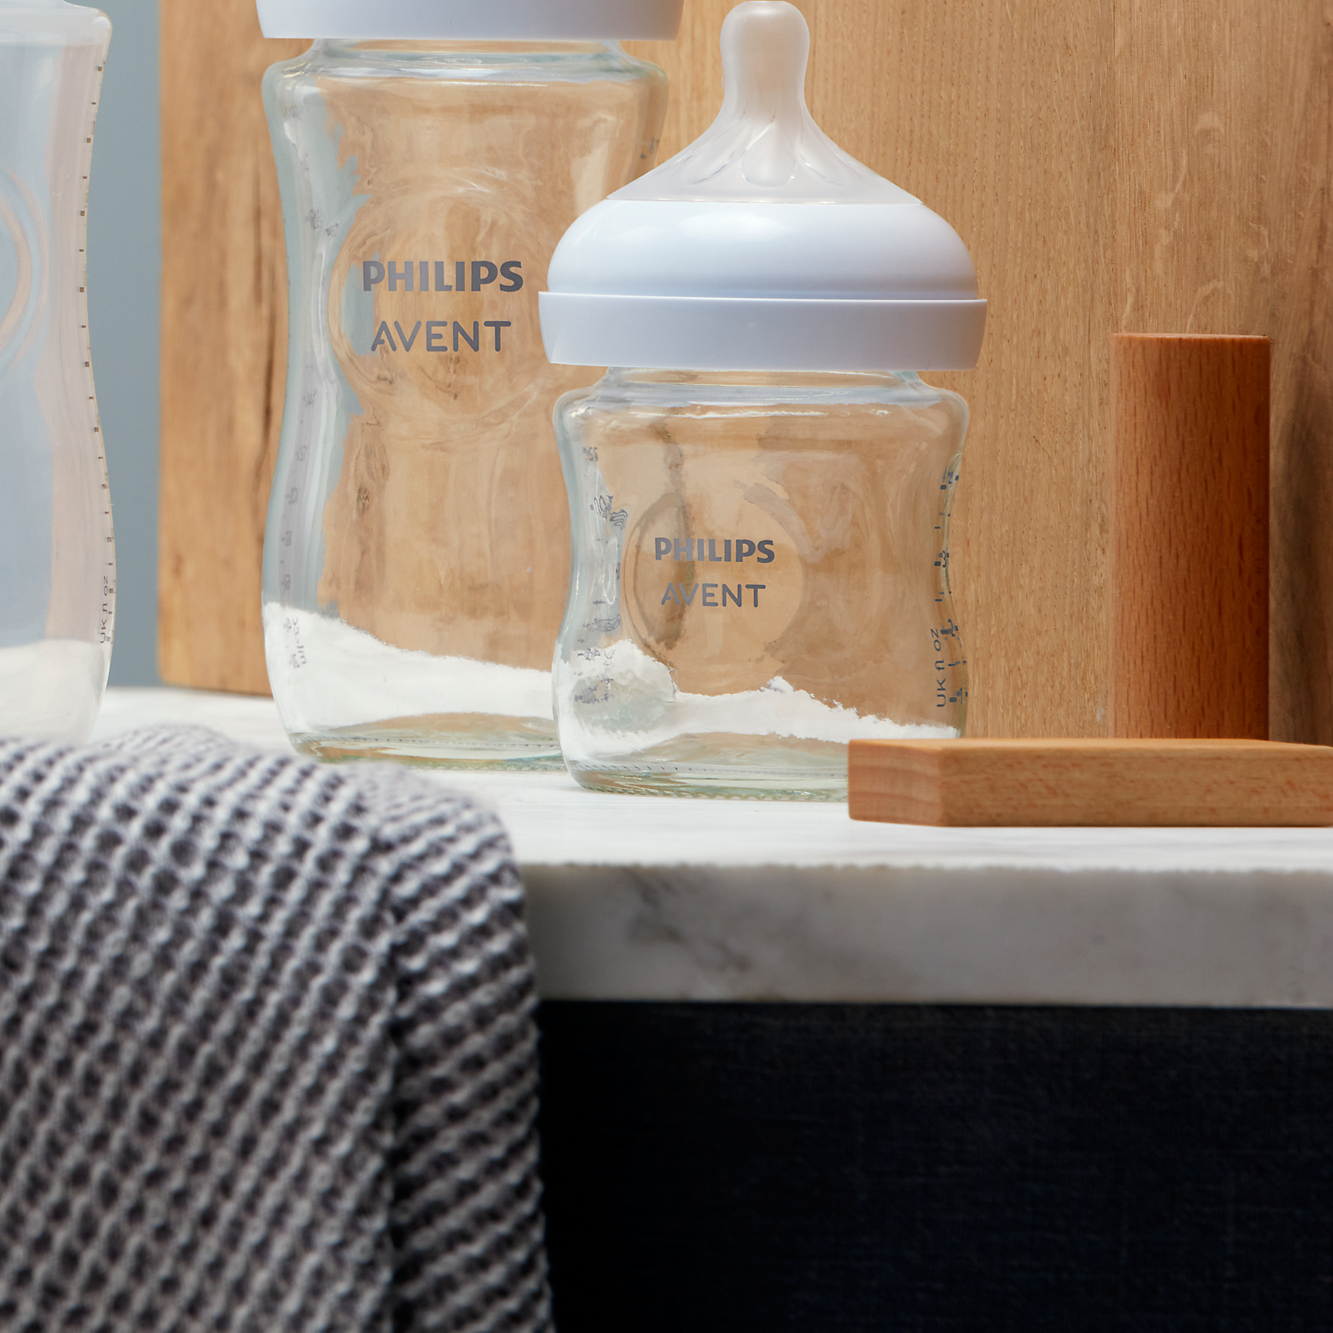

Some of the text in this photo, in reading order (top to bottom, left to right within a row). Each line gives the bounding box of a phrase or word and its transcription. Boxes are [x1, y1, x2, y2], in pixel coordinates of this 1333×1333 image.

[362, 259, 524, 293] PHILIPS
[371, 320, 512, 353] AVENT
[654, 536, 776, 565] PHILIPS
[661, 581, 767, 609] AVENT
[936, 678, 946, 708] UK
